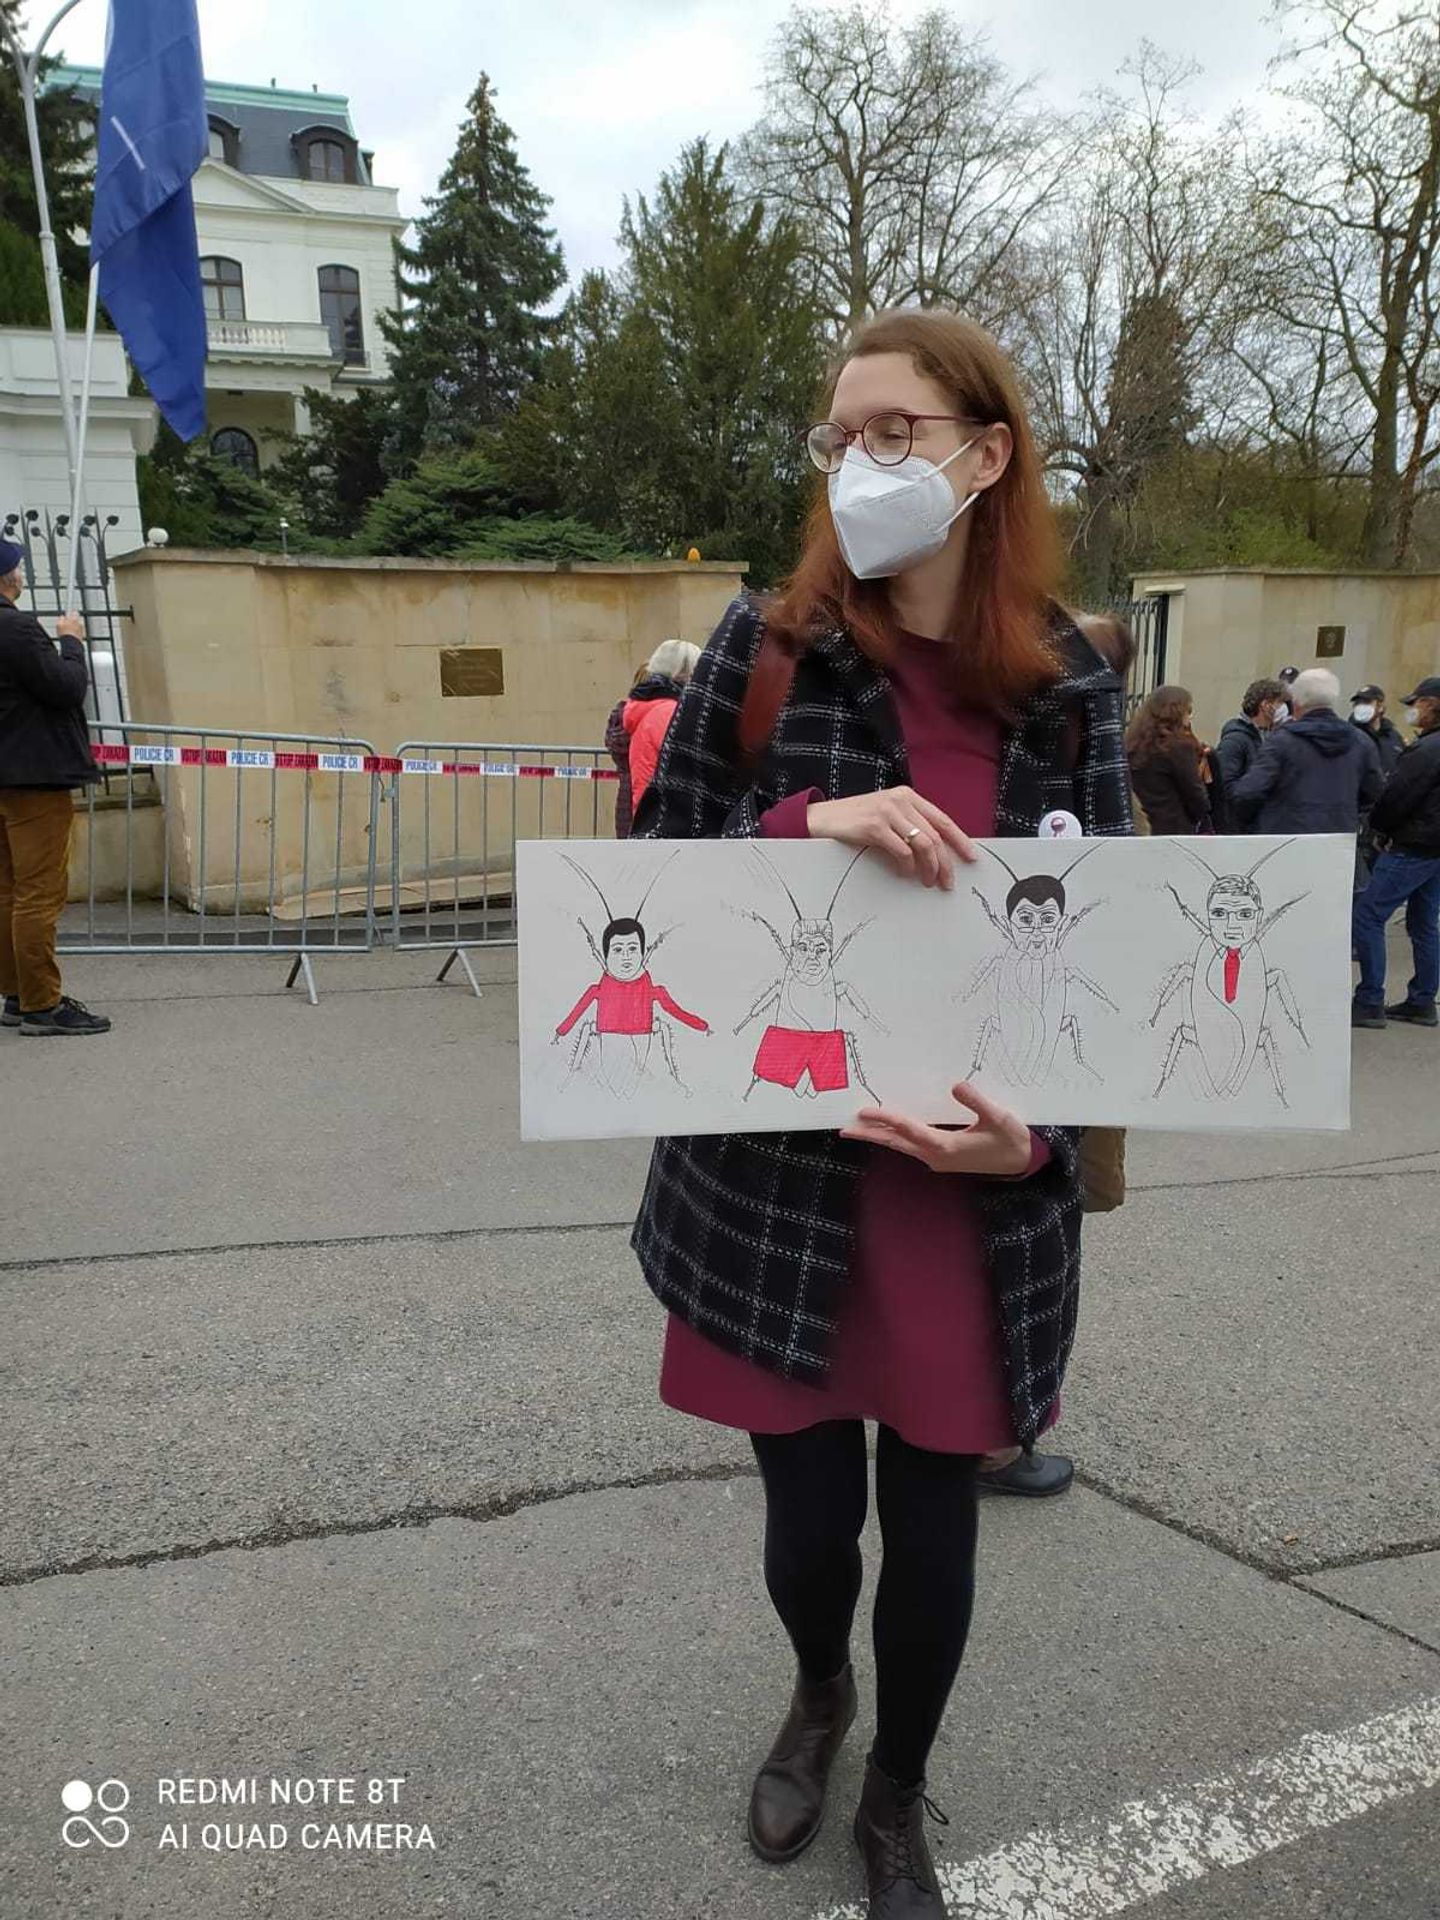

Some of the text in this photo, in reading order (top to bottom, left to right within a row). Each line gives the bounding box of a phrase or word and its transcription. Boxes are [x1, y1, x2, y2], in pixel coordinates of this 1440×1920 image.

[134, 747, 163, 761] POLICIE
[231, 751, 257, 765] POLICIE
[323, 755, 347, 769] POLICIE
